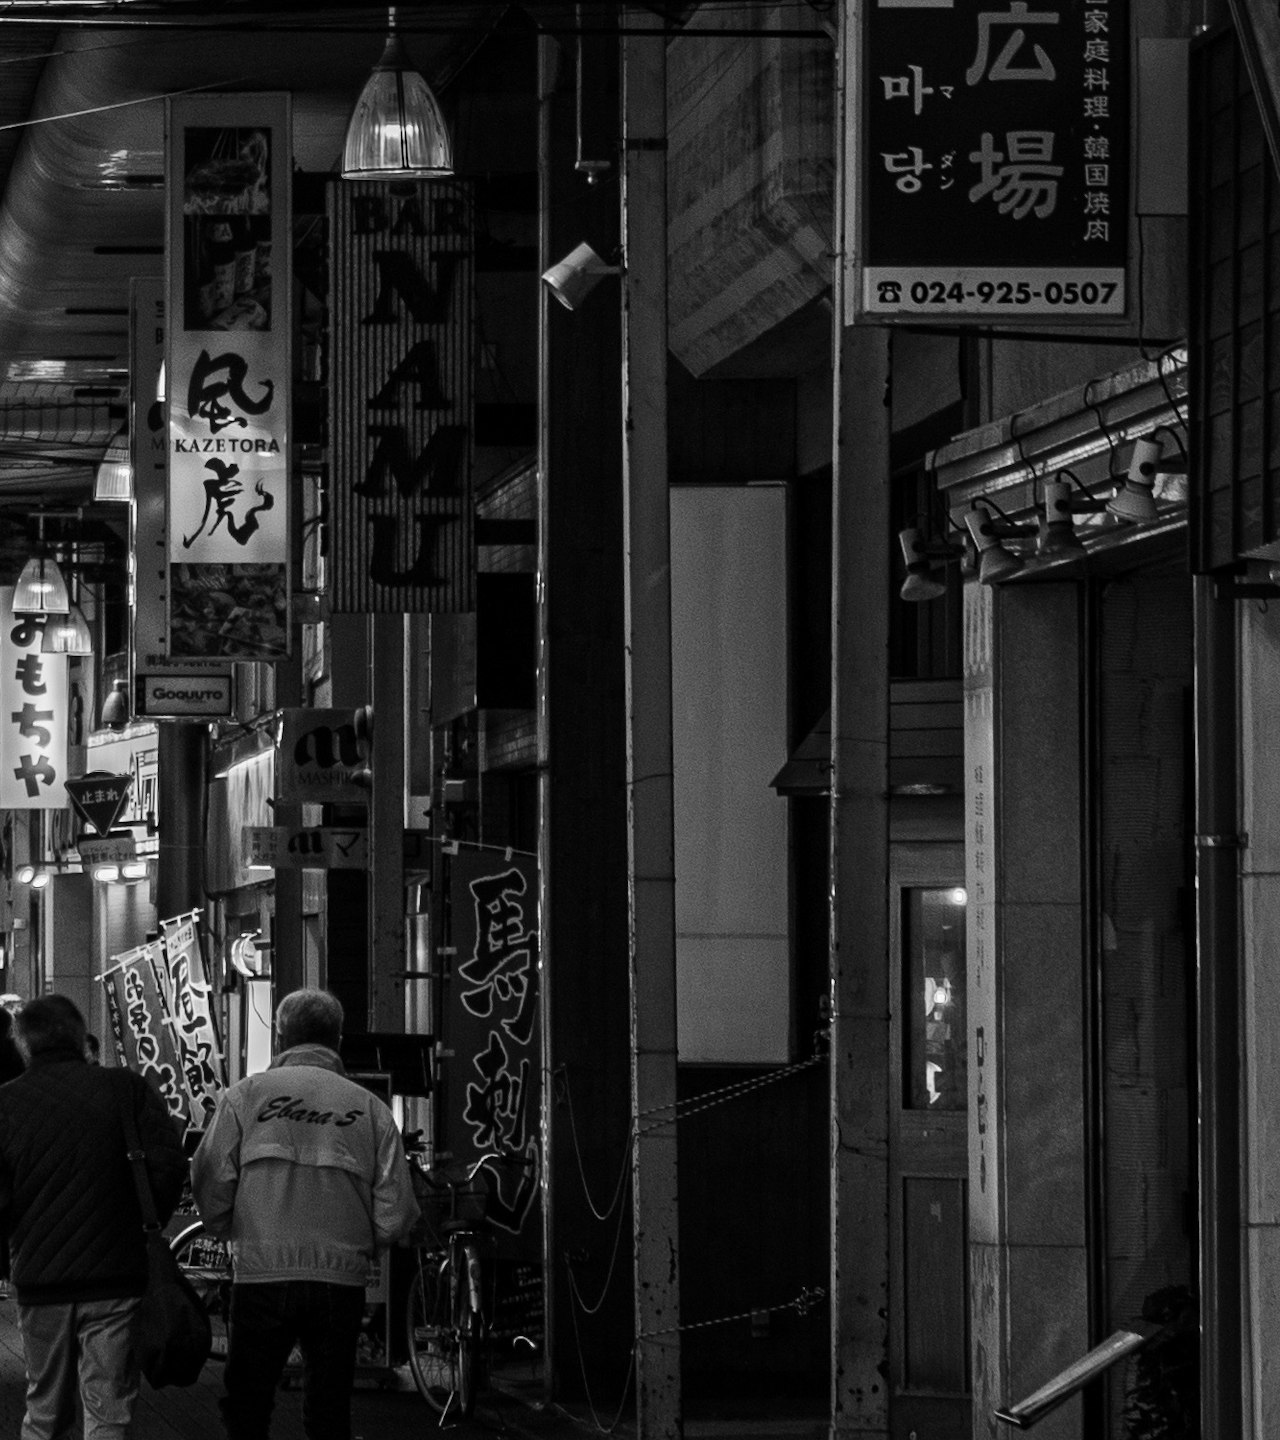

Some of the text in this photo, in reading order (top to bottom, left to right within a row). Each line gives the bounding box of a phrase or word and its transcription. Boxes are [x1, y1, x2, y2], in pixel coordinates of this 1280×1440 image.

[965, 1, 1065, 221] 広場
[878, 63, 936, 194] 마당
[353, 195, 469, 236] BAR
[910, 281, 1119, 308] 024-925-0507
[174, 437, 280, 454] KAZETORA
[297, 771, 355, 786] MASHIK
[81, 786, 119, 804] 止まれ
